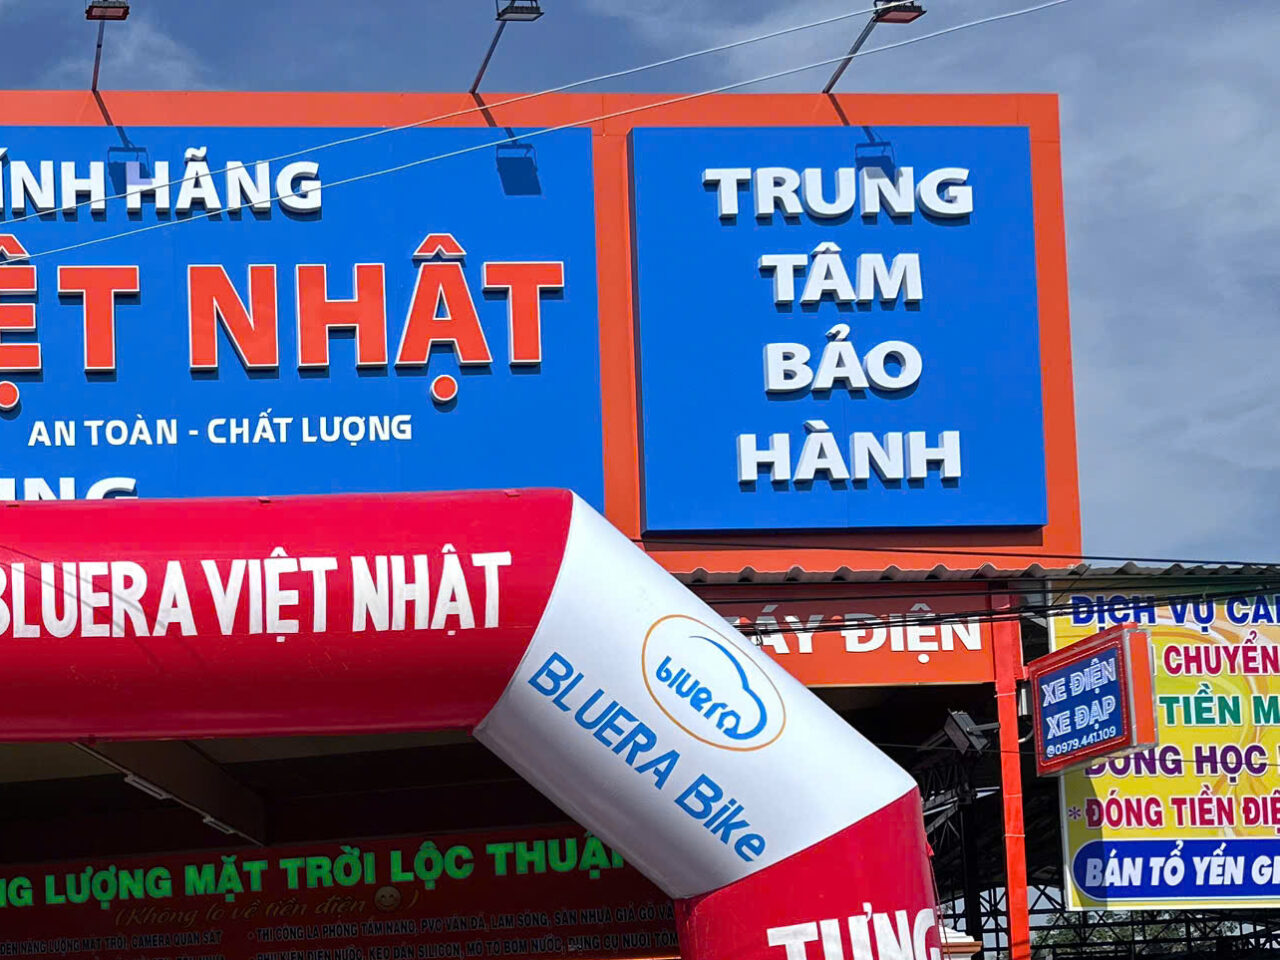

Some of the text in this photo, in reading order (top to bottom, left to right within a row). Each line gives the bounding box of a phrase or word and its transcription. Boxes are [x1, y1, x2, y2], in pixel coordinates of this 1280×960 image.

[125, 146, 322, 212] HÃNG
[702, 166, 973, 218] TRUNG
[758, 241, 923, 304] TÂM
[188, 233, 564, 403] NHẬT
[763, 323, 922, 393] BẢO
[28, 420, 76, 447] AN
[84, 413, 178, 446] TOÀN
[207, 408, 293, 445] CHẤT
[301, 414, 413, 447] LƯỢNG
[737, 420, 961, 483] HÀNH
[200, 546, 338, 643] VIỆT
[350, 543, 512, 636] NHẬT
[1071, 595, 1156, 631] DỊCH
[1168, 597, 1215, 632] VỤ
[724, 603, 982, 664] ÁY ĐIỆN
[1164, 630, 1279, 674] CHUYỂN
[1041, 658, 1117, 707] XE ĐIỆN
[1159, 683, 1241, 725] TIỀN
[1046, 696, 1117, 739] XE ĐẠP
[528, 651, 766, 862] BLUERA Bike
[1195, 745, 1267, 783] HỌC
[1086, 790, 1163, 827] ĐÓNG
[1171, 785, 1235, 826] TIỀN
[45, 865, 173, 910] LƯỢNG
[184, 855, 269, 903] MẶT
[278, 845, 376, 890] TRỜI
[390, 841, 475, 890] LỘC
[1085, 849, 1143, 887] BÁN
[1150, 840, 1185, 886] TỔ
[1193, 842, 1245, 885] YẾN
